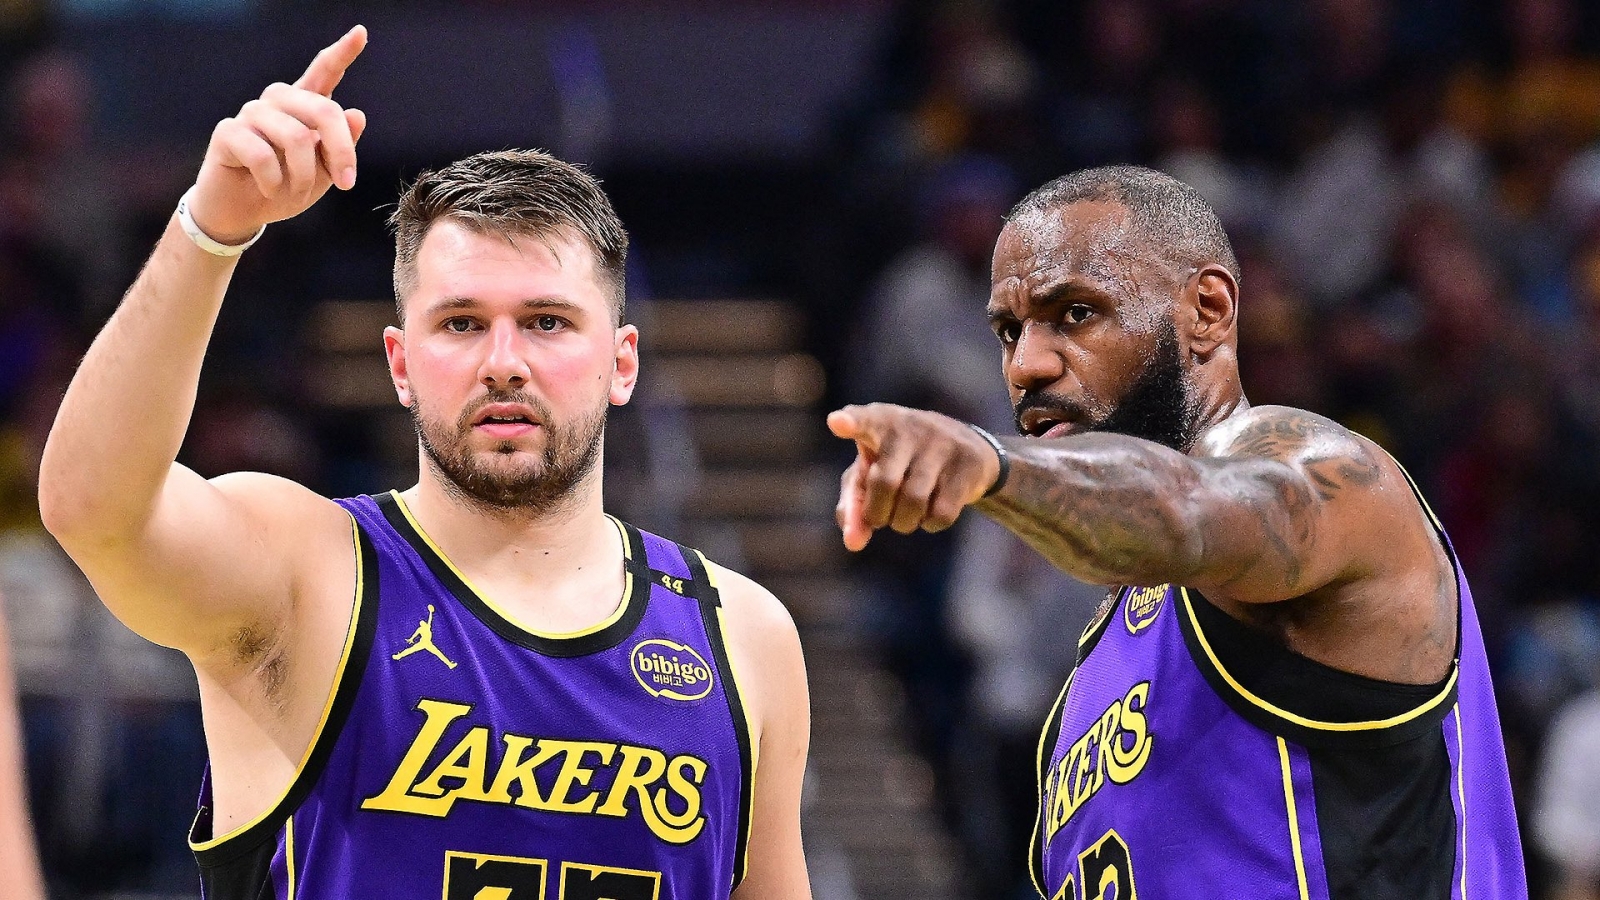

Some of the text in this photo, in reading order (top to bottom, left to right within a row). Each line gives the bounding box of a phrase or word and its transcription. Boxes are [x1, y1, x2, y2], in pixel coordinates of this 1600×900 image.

[661, 574, 684, 595] 44
[638, 653, 708, 684] bibigo
[653, 674, 683, 686] 비비고
[361, 699, 707, 844] LAKERS
